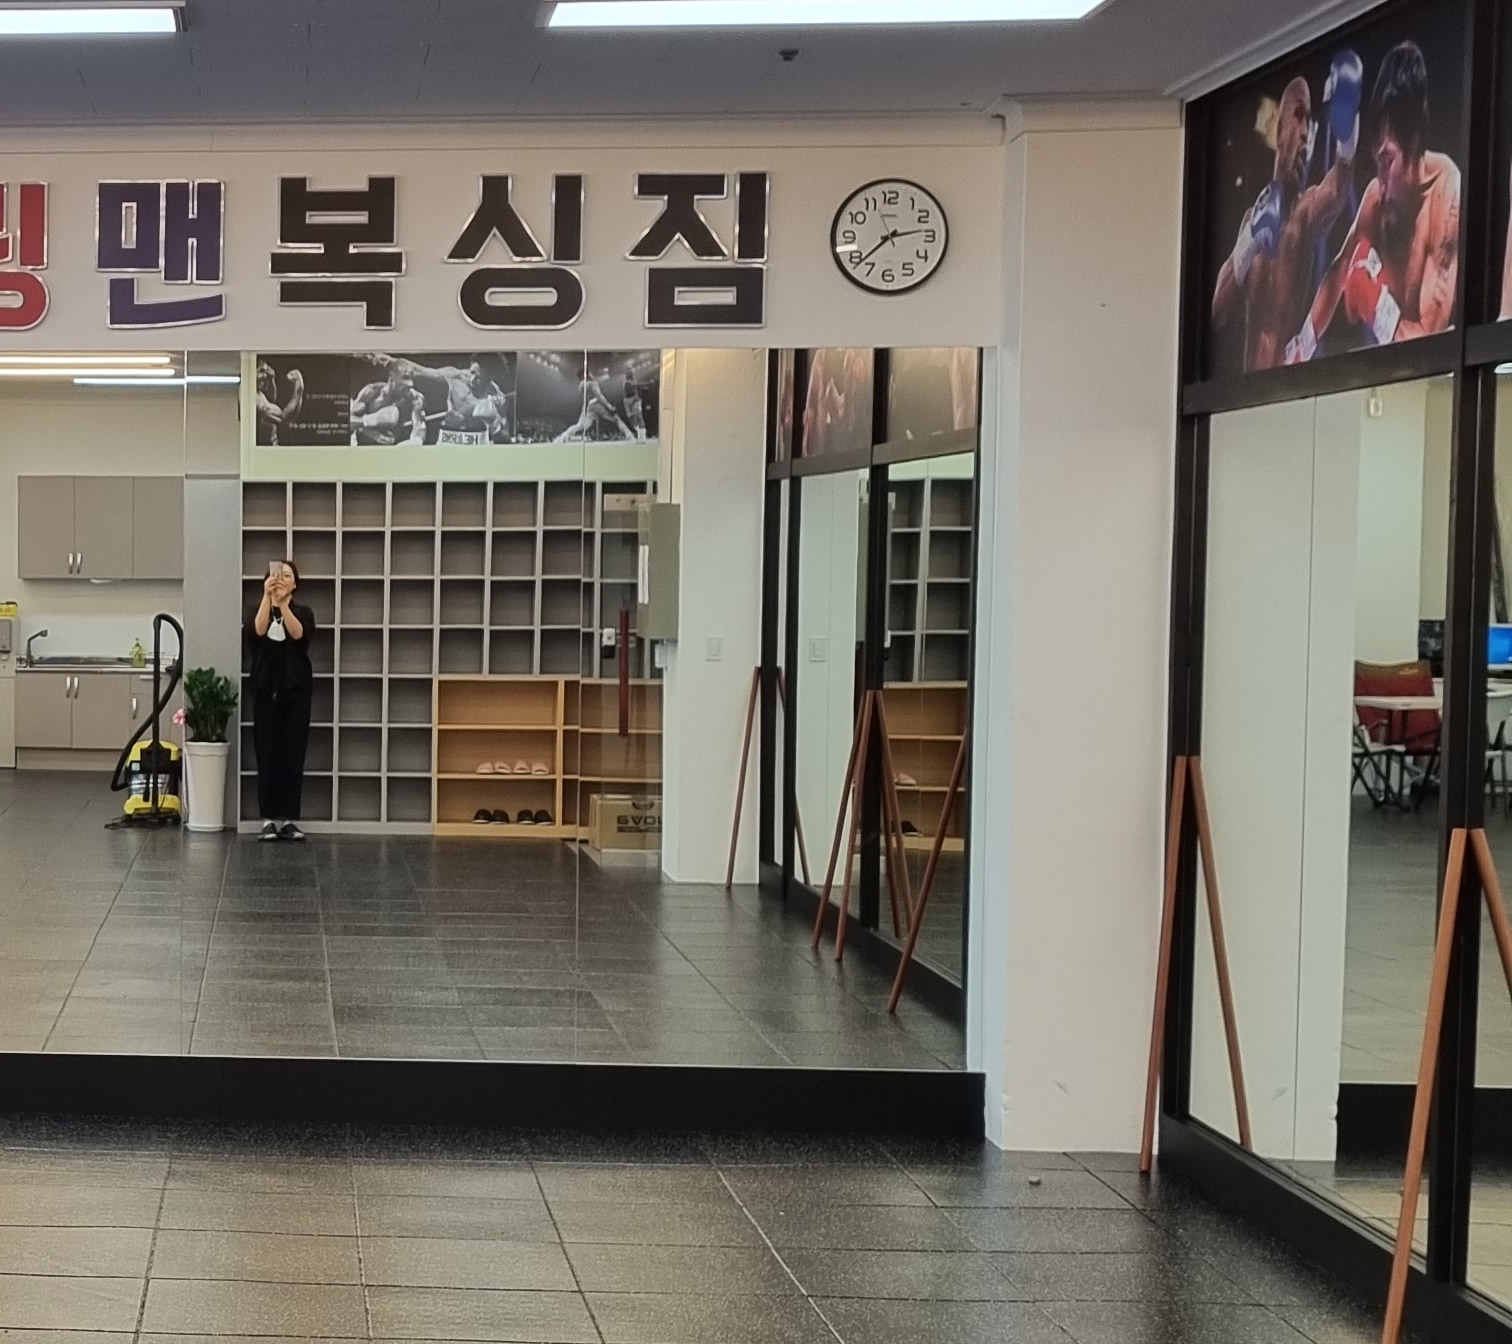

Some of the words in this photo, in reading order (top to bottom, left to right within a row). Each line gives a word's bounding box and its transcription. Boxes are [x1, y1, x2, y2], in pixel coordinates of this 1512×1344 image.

[864, 197, 877, 211] 11
[881, 190, 899, 205] 12
[910, 196, 915, 210] 1
[849, 211, 866, 225] 10
[917, 209, 930, 224] 2
[842, 230, 857, 244] 9
[923, 229, 936, 243] 3
[849, 250, 863, 265] 8
[916, 248, 929, 263] 4
[864, 262, 876, 277] 7
[881, 268, 895, 283] 6
[902, 262, 915, 276] 5
